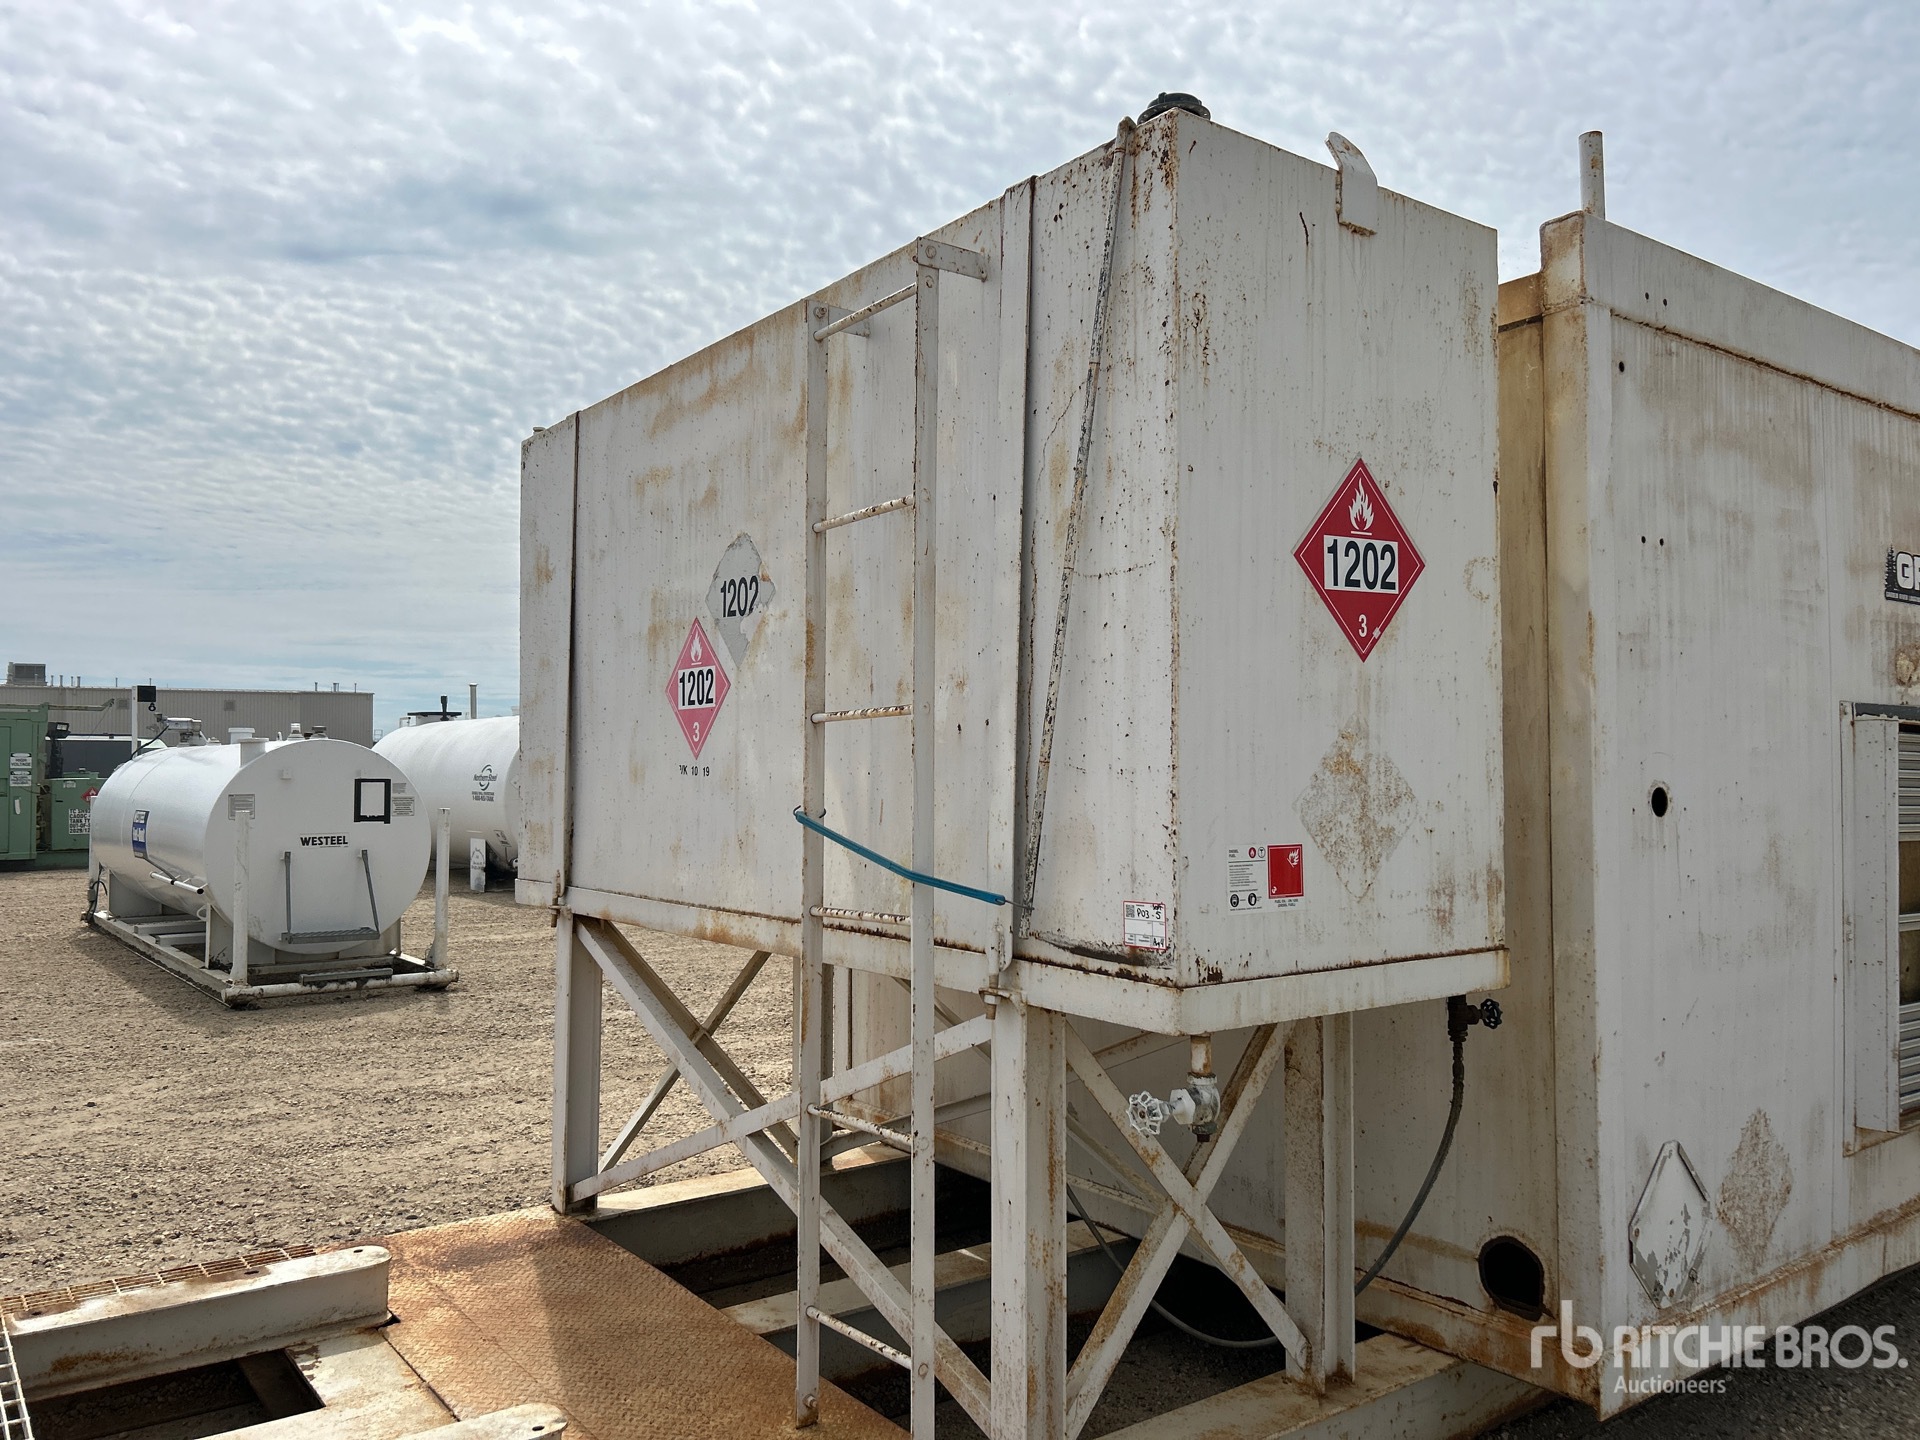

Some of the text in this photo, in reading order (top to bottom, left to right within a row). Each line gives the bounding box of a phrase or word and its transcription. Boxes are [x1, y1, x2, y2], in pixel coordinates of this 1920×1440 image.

[1327, 538, 1396, 590] 1202
[720, 575, 759, 618] 1202
[1358, 614, 1368, 638] 3
[679, 668, 714, 706] 1202
[692, 721, 700, 742] 3
[691, 765, 699, 775] 10
[702, 766, 710, 777] 19
[300, 835, 348, 846] WESTEEL
